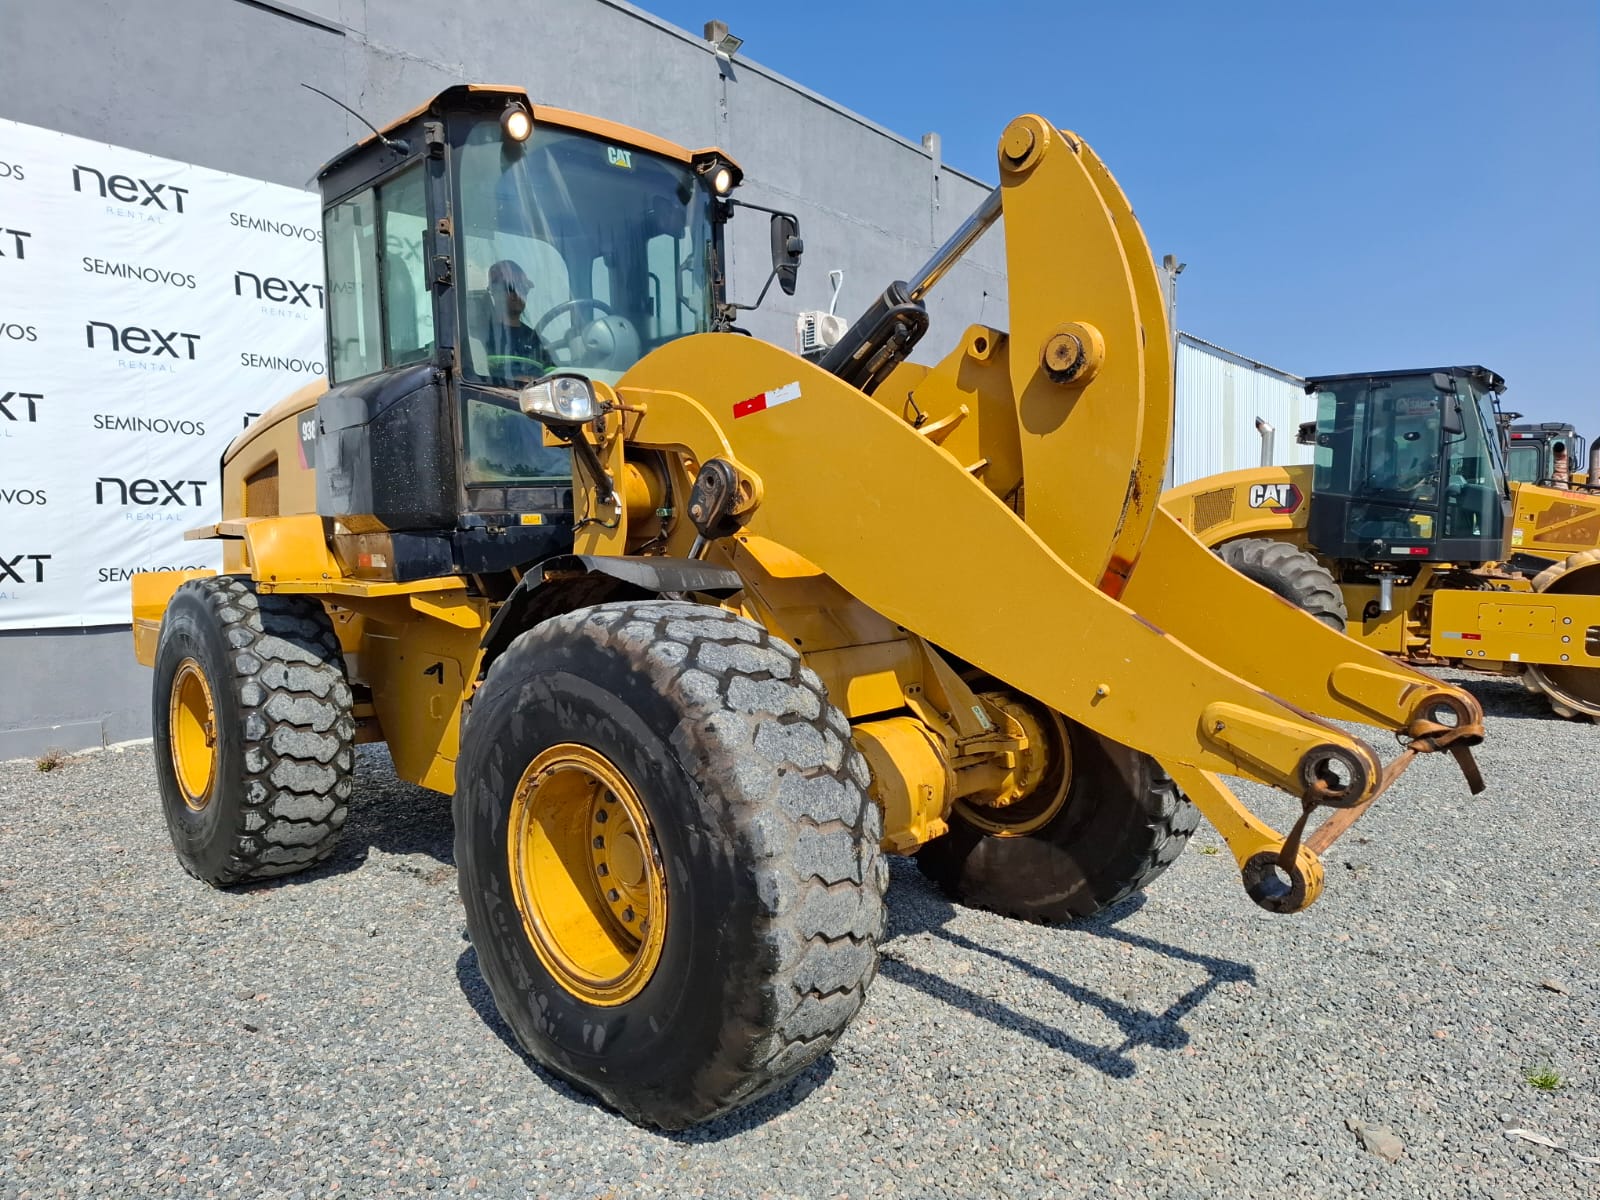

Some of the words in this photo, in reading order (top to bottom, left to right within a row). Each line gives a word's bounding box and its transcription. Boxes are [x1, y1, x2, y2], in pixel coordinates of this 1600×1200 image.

[607, 146, 631, 168] CAT
[105, 206, 165, 225] RENTAL
[230, 212, 323, 244] SEMINOVOS
[82, 256, 197, 289] SEMINOVOS
[117, 359, 177, 373] RENTAL
[241, 352, 325, 375] SEMINOVO
[93, 414, 206, 436] SEMINOVOS
[1250, 484, 1290, 508] CAT
[126, 512, 183, 521] RENTAL
